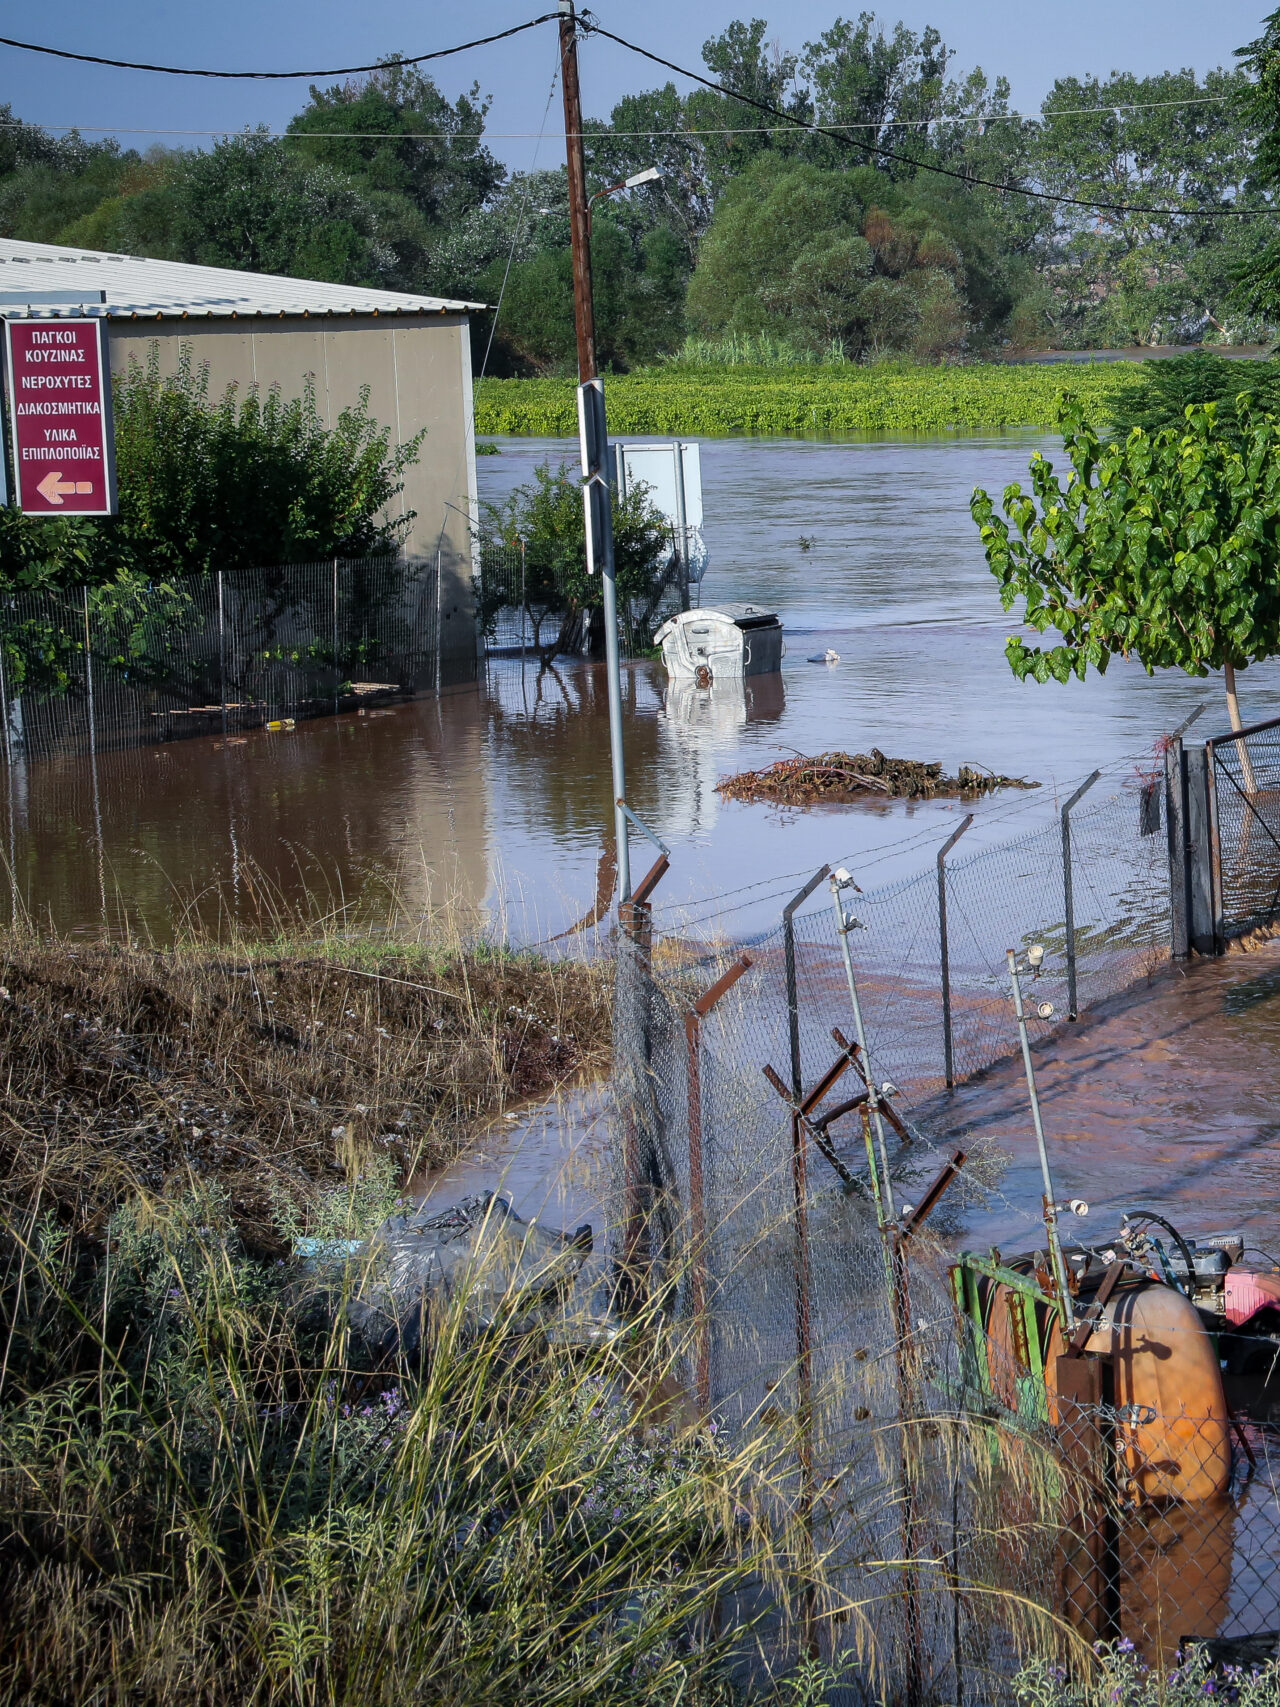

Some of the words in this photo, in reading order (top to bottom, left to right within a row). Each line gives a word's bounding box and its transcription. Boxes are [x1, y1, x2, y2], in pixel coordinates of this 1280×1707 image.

[32, 331, 76, 344] ΠΑΓΚΟΙ
[25, 349, 86, 362] ΚΟΥΖΙΝΑΣ
[22, 376, 92, 389] ΝΕΡΟΧΥΤΕΣ
[17, 402, 100, 415] ΔΙΑΚΟΣΜΗΤΙΚΑ
[44, 429, 77, 441] ΥΛΙΚΑ
